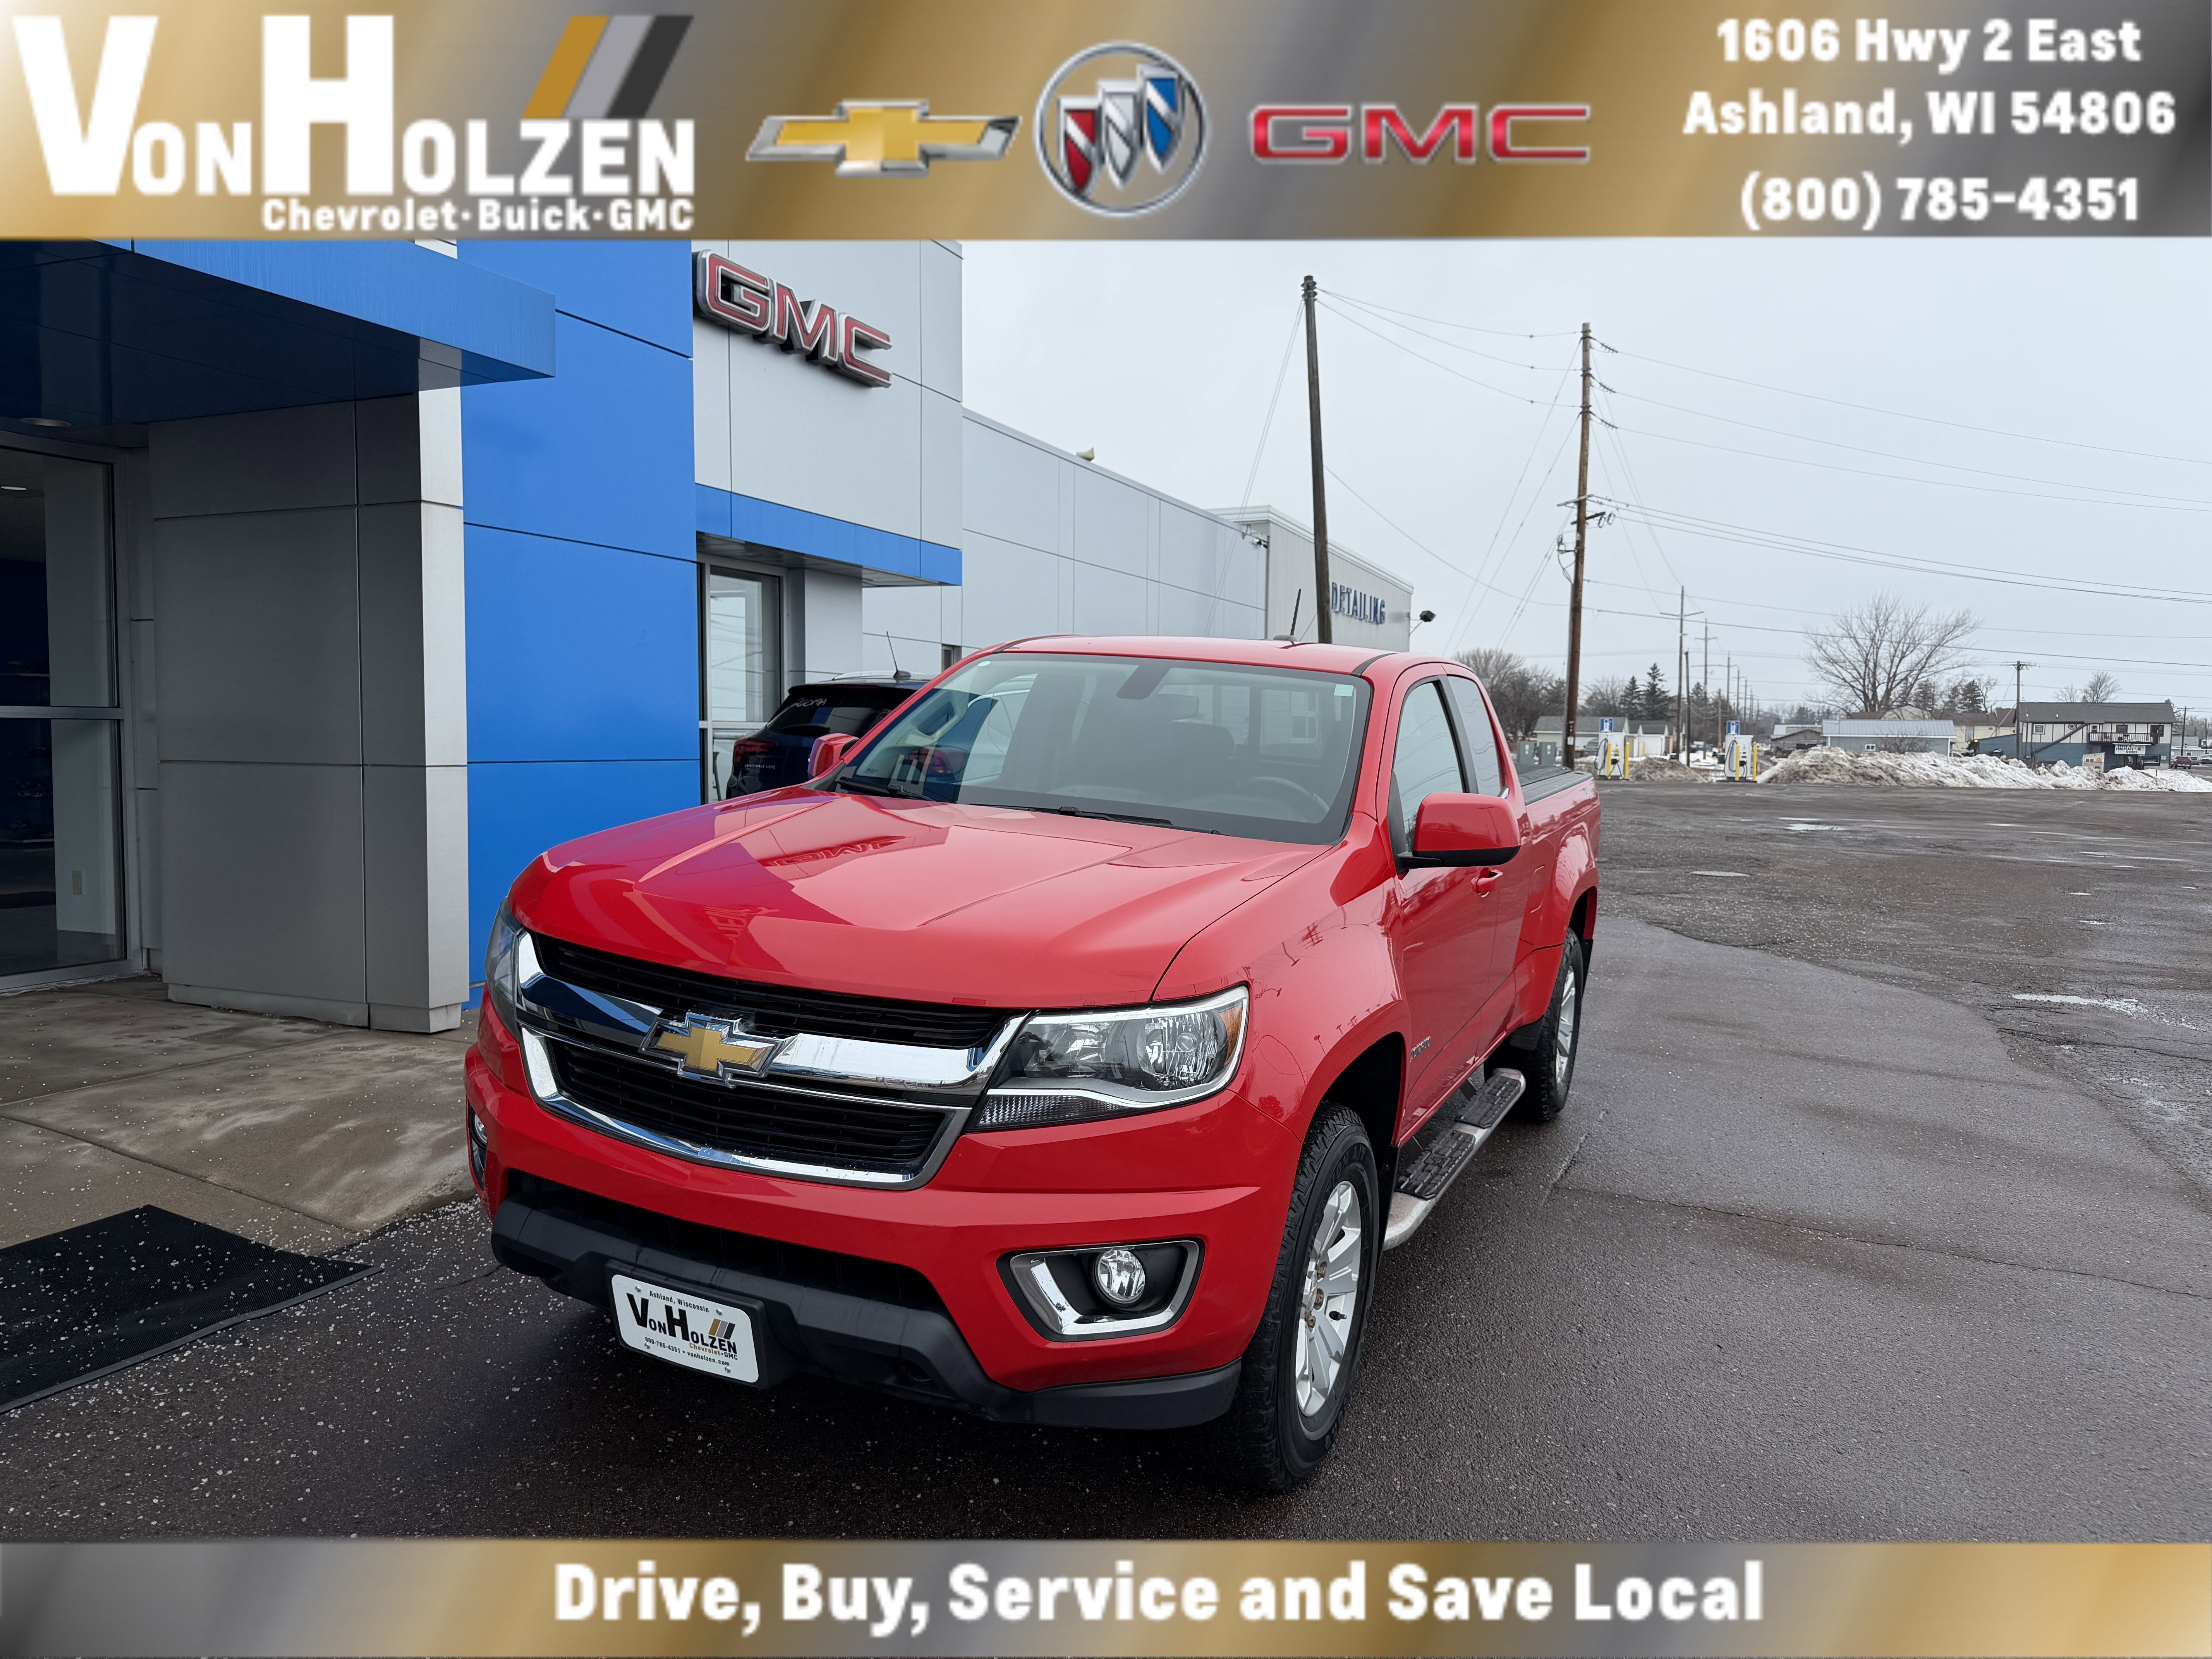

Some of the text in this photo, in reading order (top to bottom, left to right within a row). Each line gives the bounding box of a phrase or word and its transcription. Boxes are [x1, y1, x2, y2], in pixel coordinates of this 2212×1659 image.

[697, 249, 892, 388] GMC
[1331, 582, 1385, 625] DETAILING
[649, 1290, 709, 1313] Ashland, Wisconsin
[645, 1336, 730, 1366] 800-785-4351 vonholzen.com
